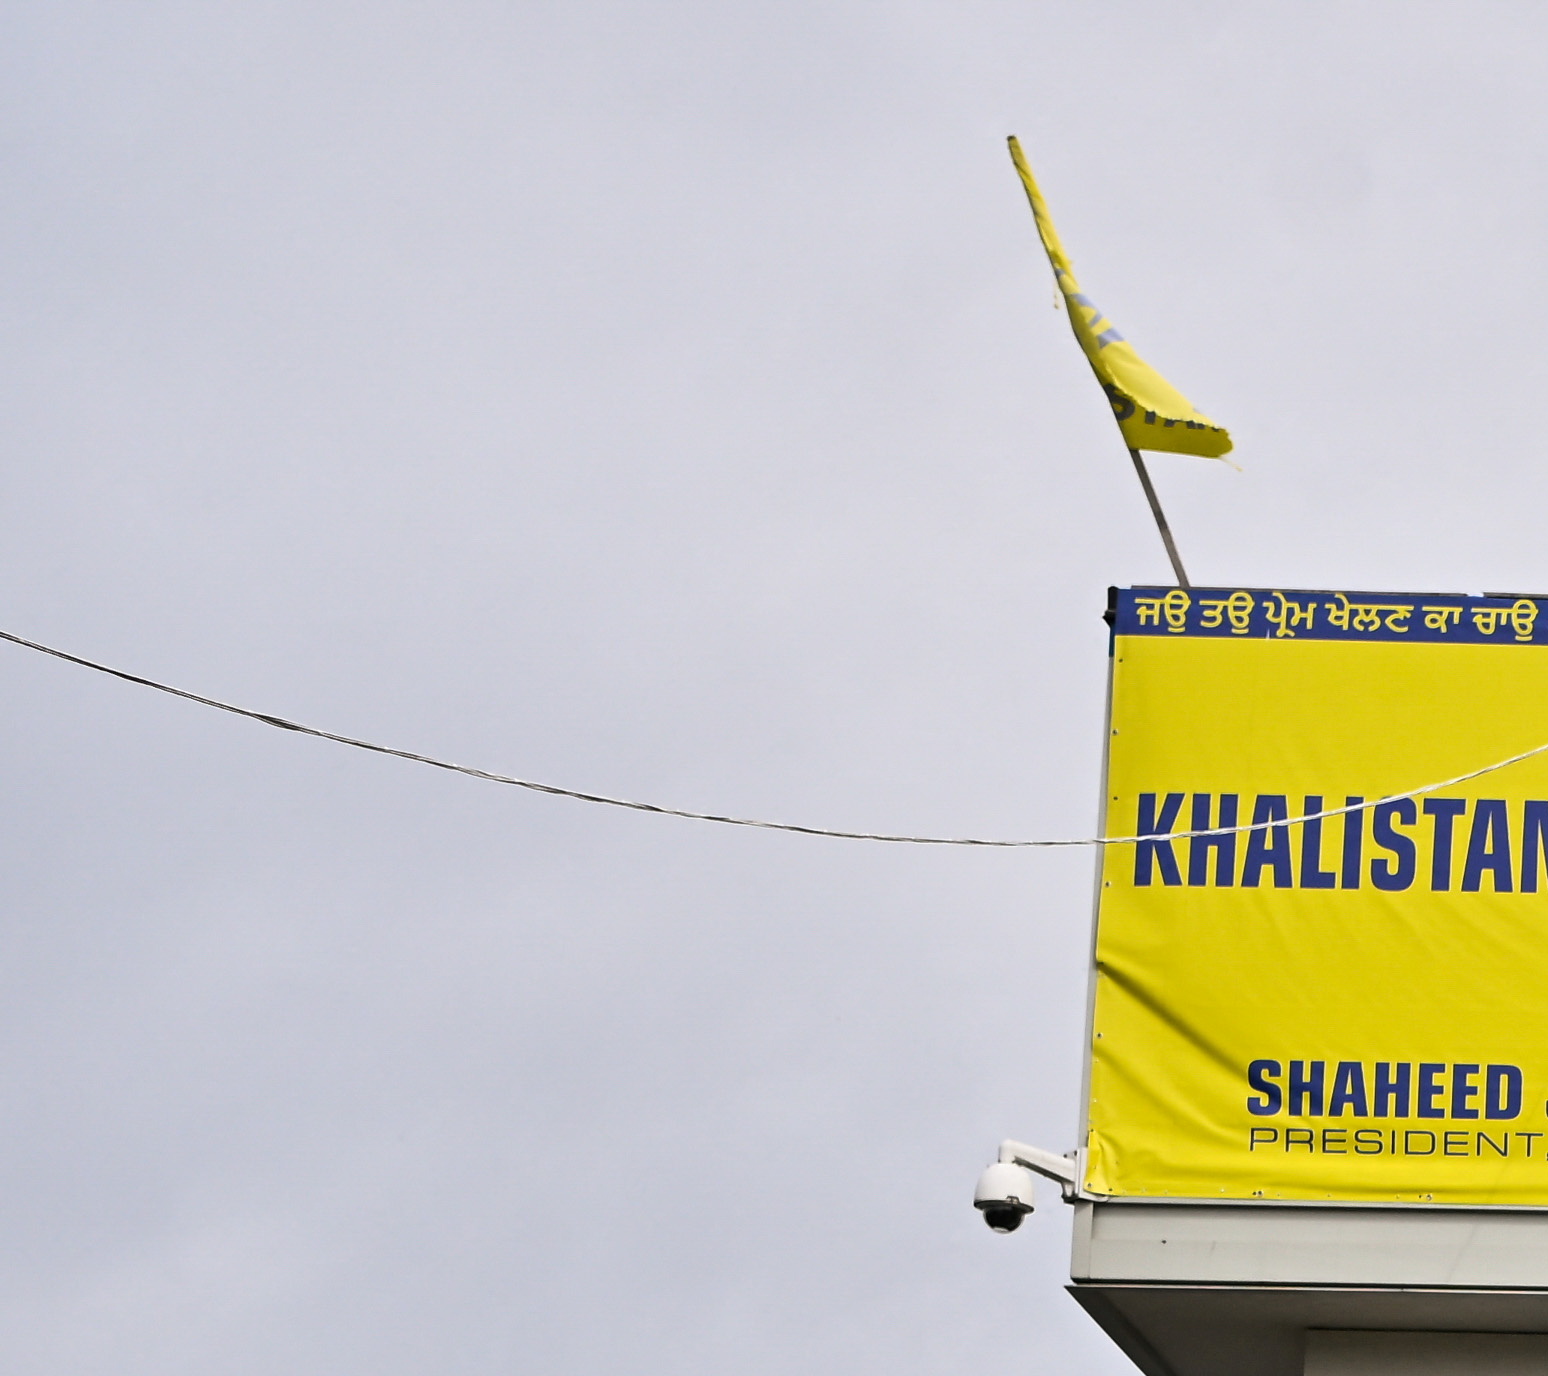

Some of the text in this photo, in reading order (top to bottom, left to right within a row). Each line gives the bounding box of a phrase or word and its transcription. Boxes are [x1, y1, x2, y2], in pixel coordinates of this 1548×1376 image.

[1134, 589, 1191, 633] ਜਉ
[1199, 591, 1255, 635] ਤਉ
[1262, 592, 1317, 638] ਪ੍ਰੇਮ
[1323, 593, 1414, 634] ਖੇਲਣ
[1421, 605, 1463, 634] ਕਾ
[1471, 598, 1538, 642] ਚਾਉ
[1246, 1058, 1524, 1122] SHAHEED
